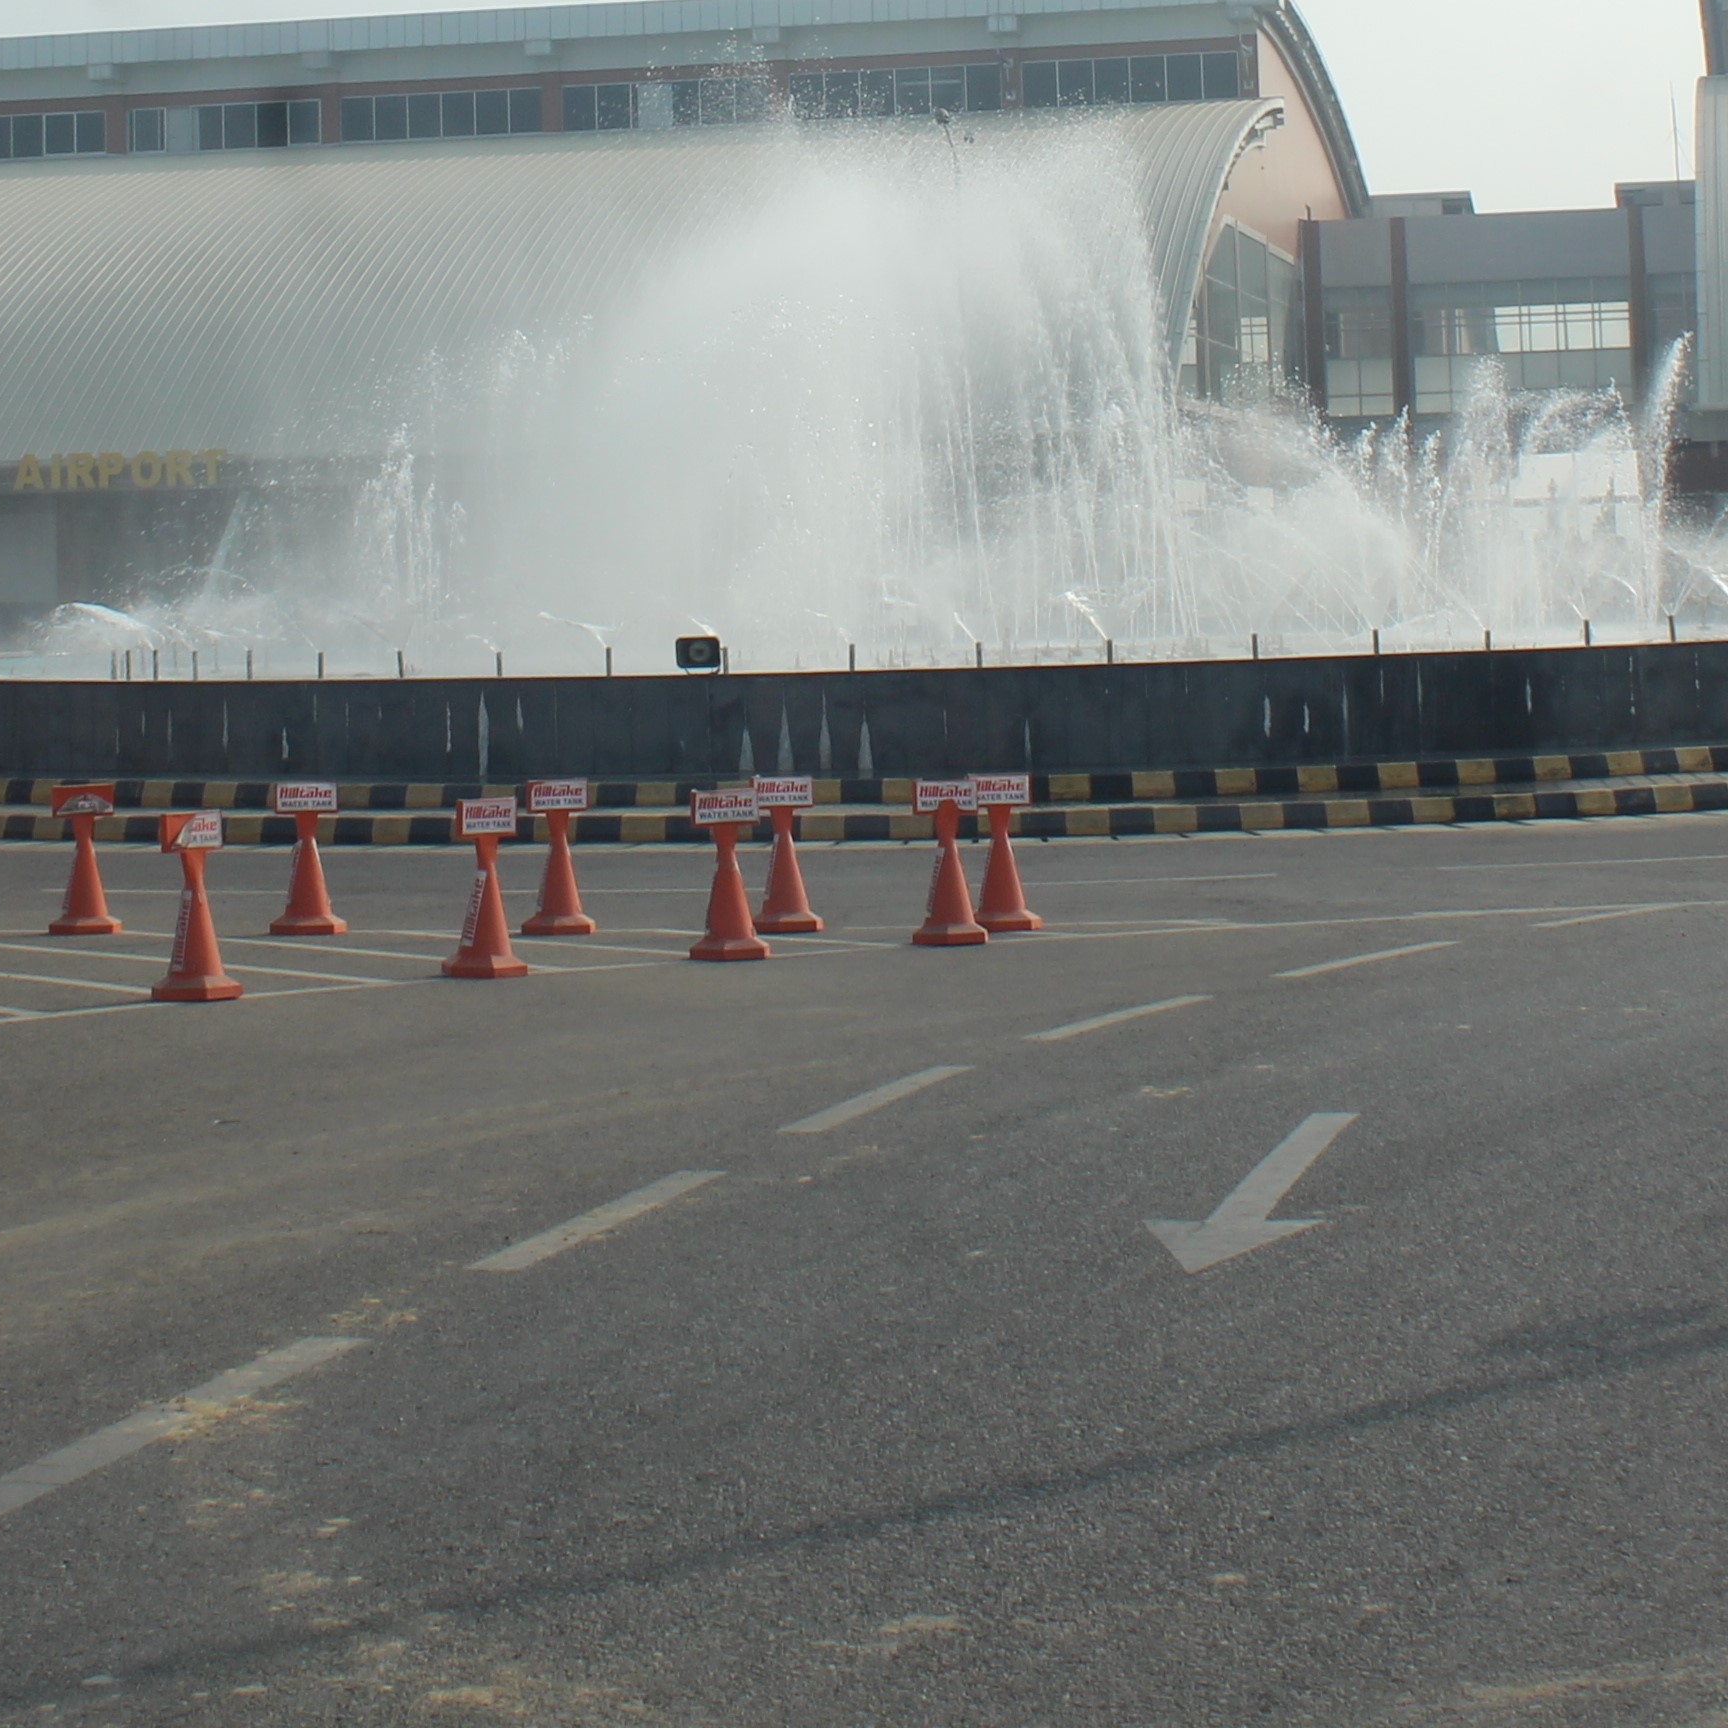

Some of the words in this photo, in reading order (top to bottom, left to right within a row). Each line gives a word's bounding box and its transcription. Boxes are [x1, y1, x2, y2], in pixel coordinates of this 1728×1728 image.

[13, 448, 227, 492] AIRPORT
[279, 786, 332, 798] Hilltake
[534, 784, 583, 797] Hilltake
[758, 781, 808, 792] Hilltake
[920, 785, 972, 798] Hilltake
[698, 795, 752, 810] Hilltake
[699, 811, 729, 820] WATER
[732, 810, 754, 818] TANK
